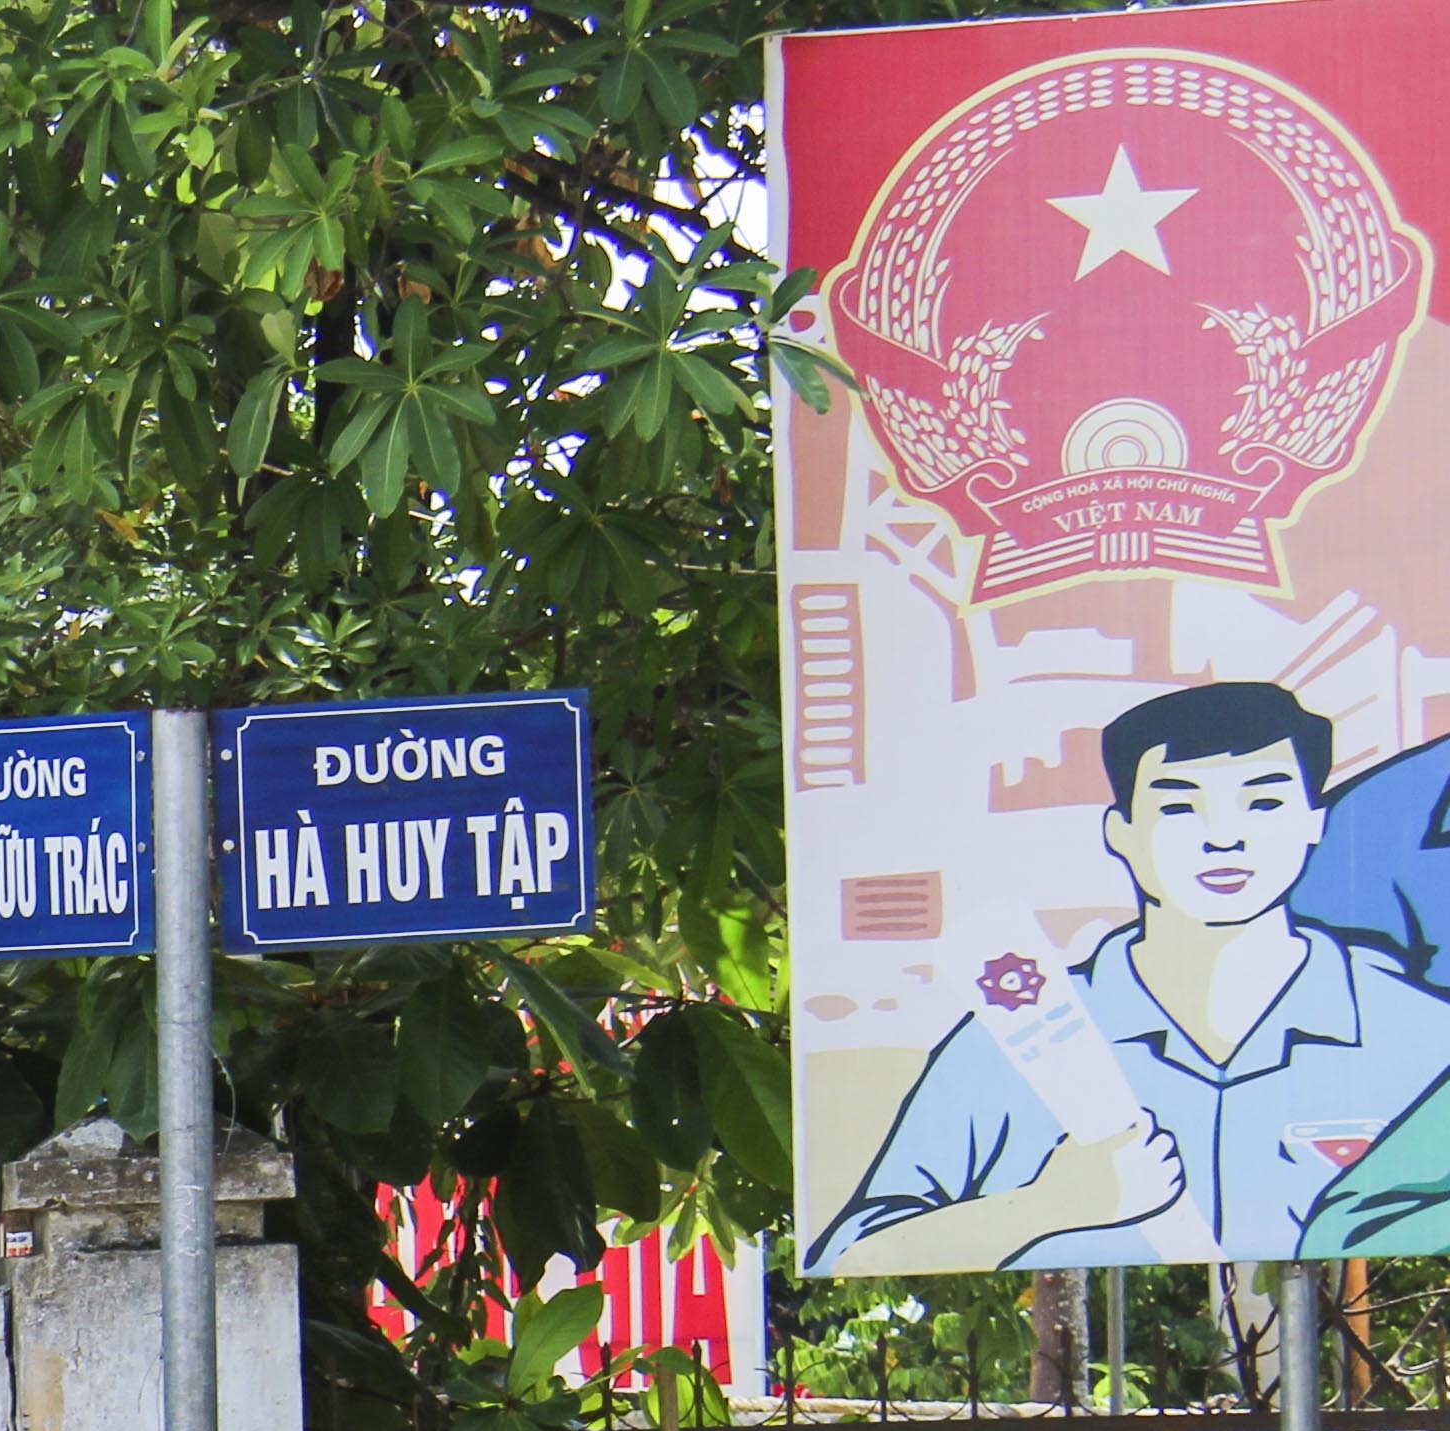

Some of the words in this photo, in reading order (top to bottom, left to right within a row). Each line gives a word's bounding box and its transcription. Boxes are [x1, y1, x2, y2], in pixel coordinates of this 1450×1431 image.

[1052, 500, 1126, 532] VIỆT
[1134, 501, 1204, 527] NAM
[313, 729, 507, 787] ĐƯỜNG
[44, 817, 129, 916] TRÁC
[254, 810, 331, 910] HÀ
[344, 818, 450, 905] HUY
[466, 797, 570, 910] TẬP
